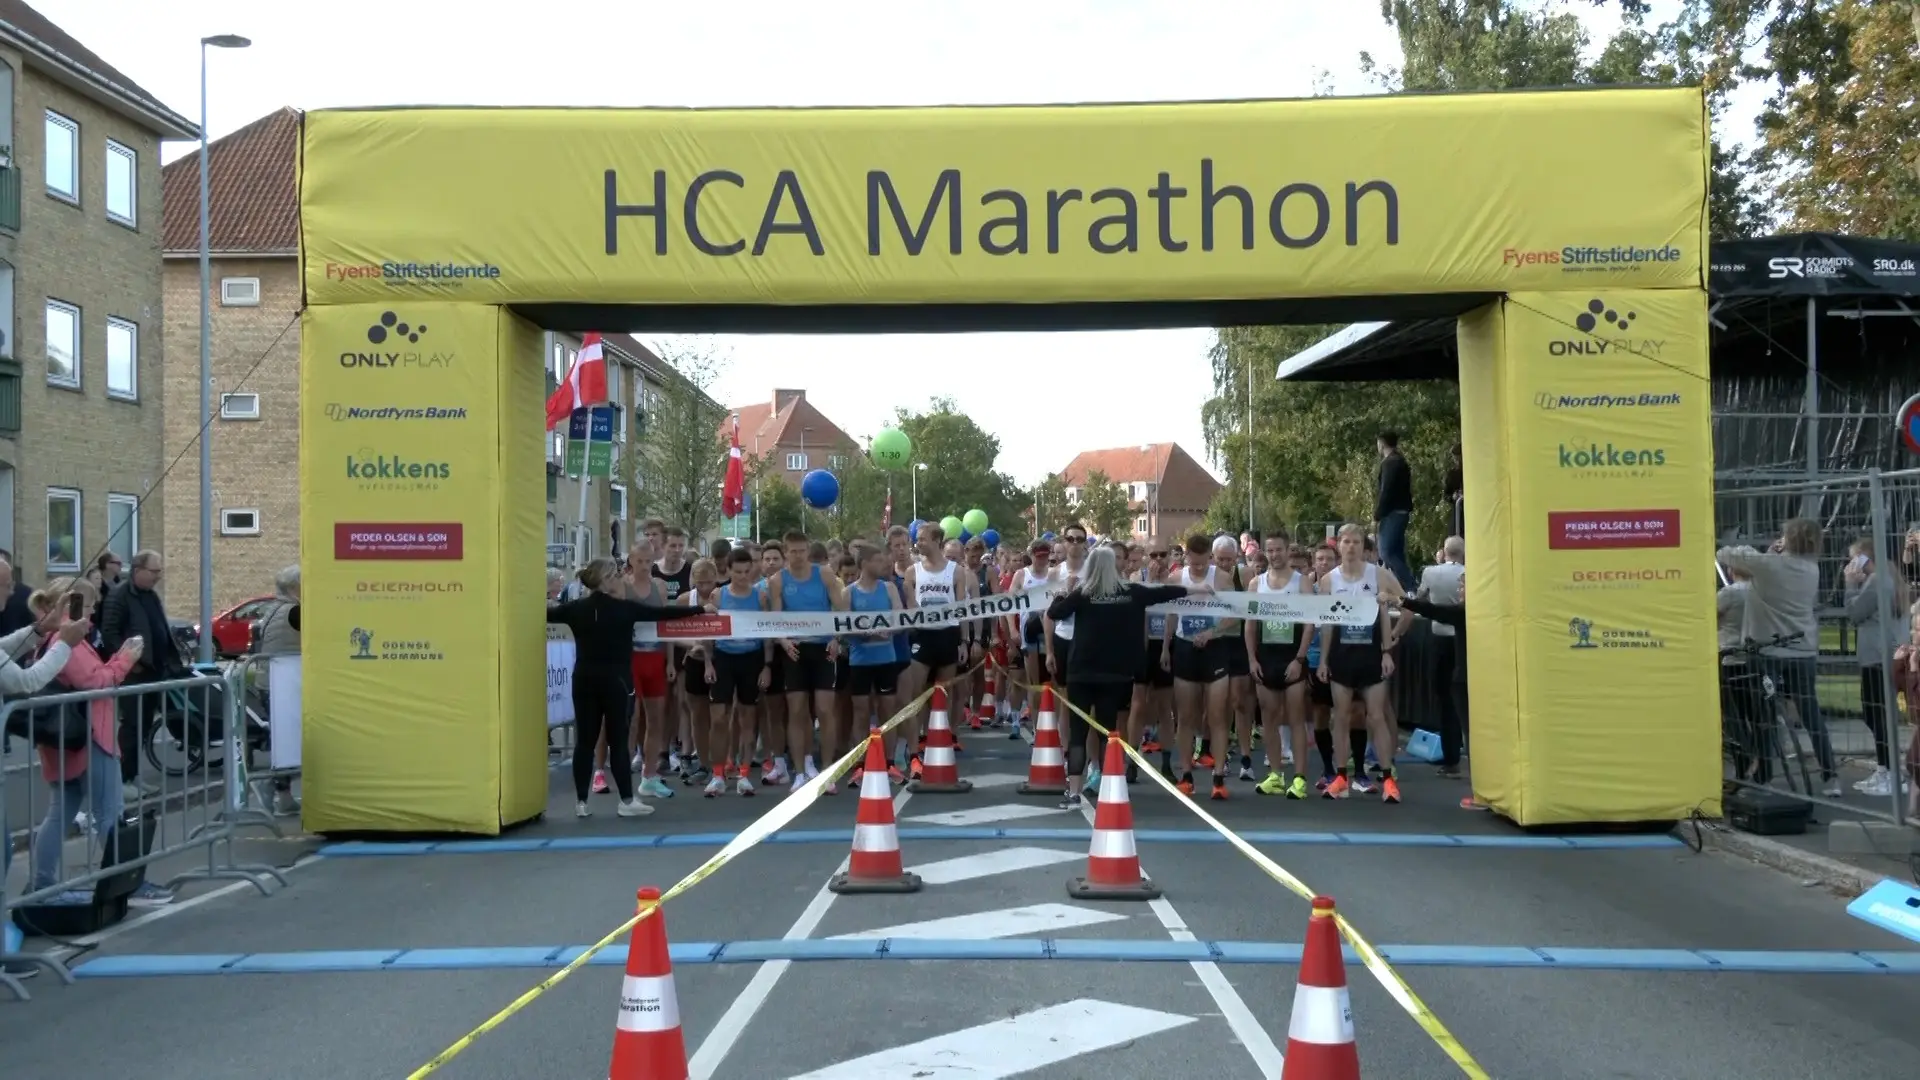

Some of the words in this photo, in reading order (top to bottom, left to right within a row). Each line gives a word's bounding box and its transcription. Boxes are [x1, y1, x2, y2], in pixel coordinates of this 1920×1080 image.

[604, 168, 825, 258] HCA
[868, 158, 1399, 258] Marathon
[1768, 257, 1805, 278] SR
[1805, 257, 1854, 266] SCHMIDTS
[1872, 258, 1915, 271] SRO.dk
[1805, 266, 1836, 274] RADIO
[1548, 340, 1609, 356] ONLY
[1612, 339, 1666, 354] PLAY
[340, 352, 400, 368] ONLY
[403, 352, 455, 368] PLAY
[1565, 522, 1597, 531] PEDER
[1599, 521, 1632, 530] OLSEN
[1634, 520, 1641, 529] &
[350, 533, 382, 542] PEDER
[384, 533, 416, 542] OLSEN
[418, 533, 425, 542] &
[1572, 569, 1682, 582] BEIERHOLM
[356, 582, 463, 592] BEIERHOLM
[833, 613, 891, 632] HCA
[899, 592, 1031, 626] Marathon
